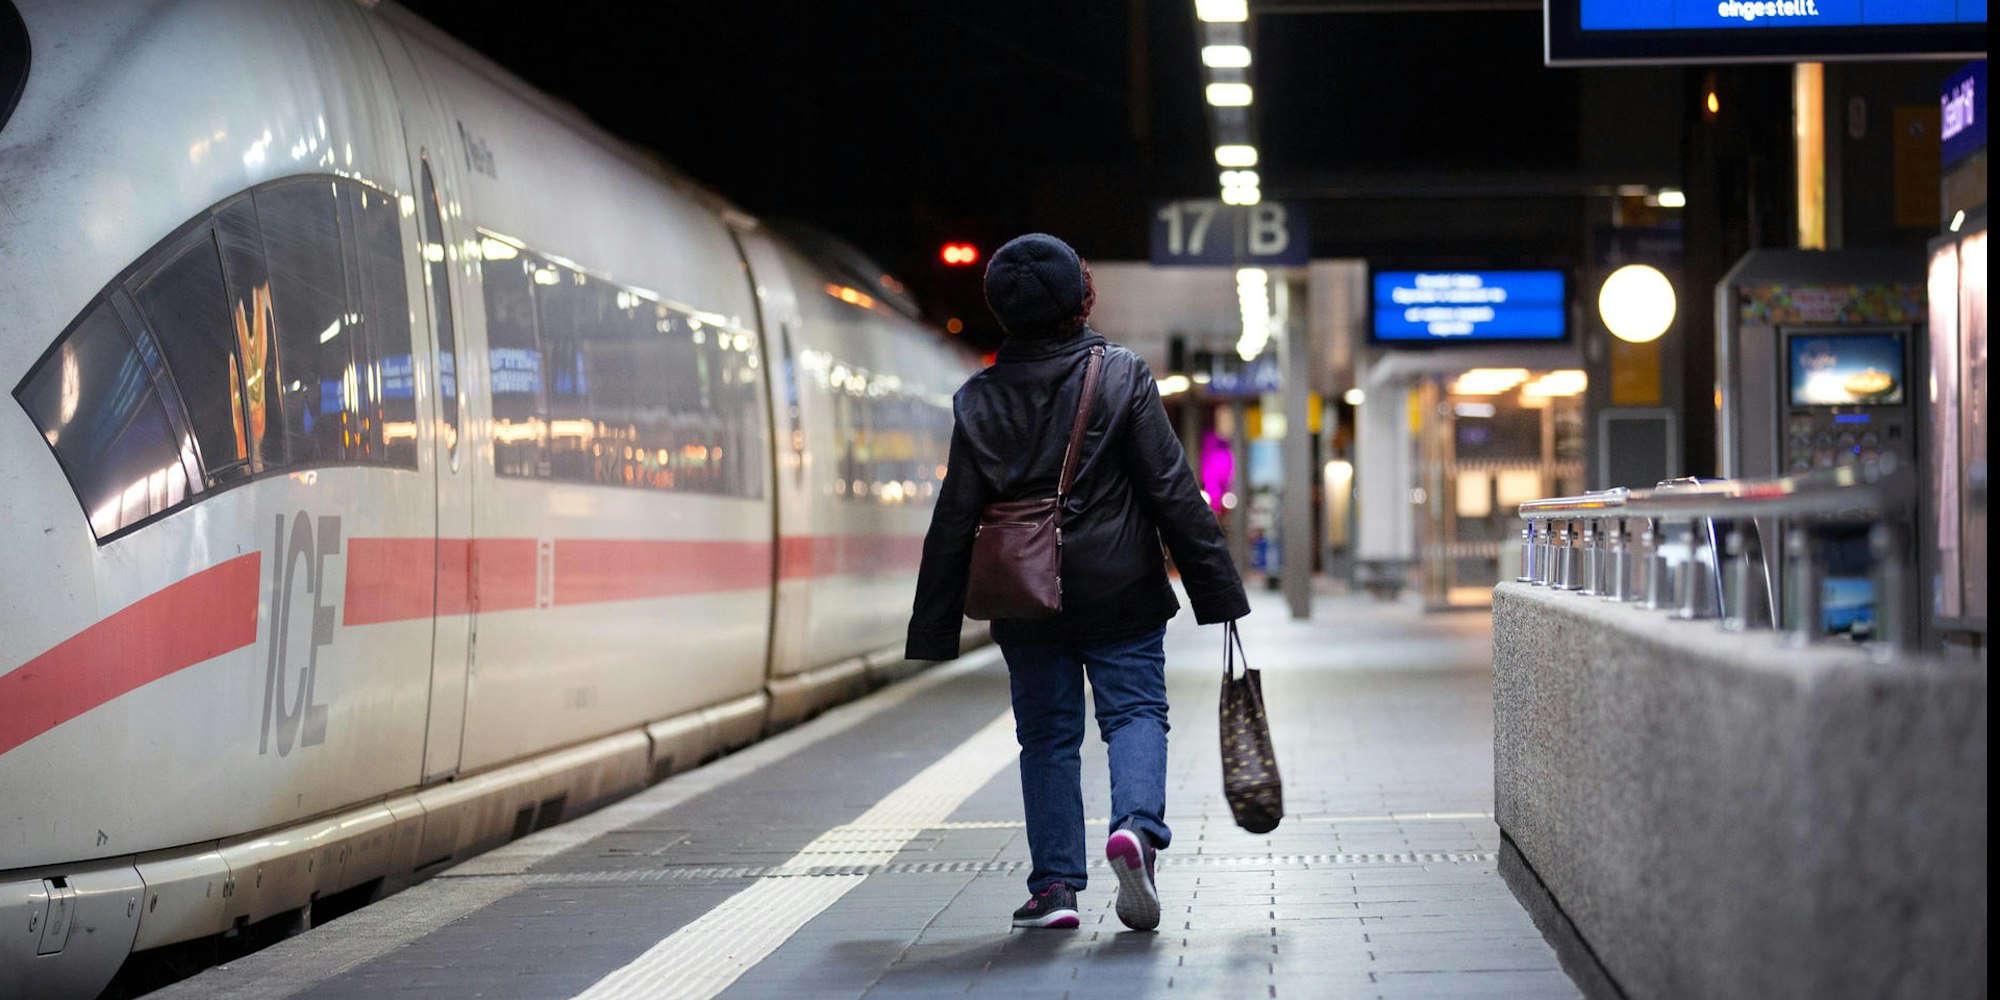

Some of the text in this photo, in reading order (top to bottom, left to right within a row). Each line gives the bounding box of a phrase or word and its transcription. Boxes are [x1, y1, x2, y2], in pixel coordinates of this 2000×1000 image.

[1157, 201, 1290, 256] 17 B
[259, 510, 341, 758] ICE
